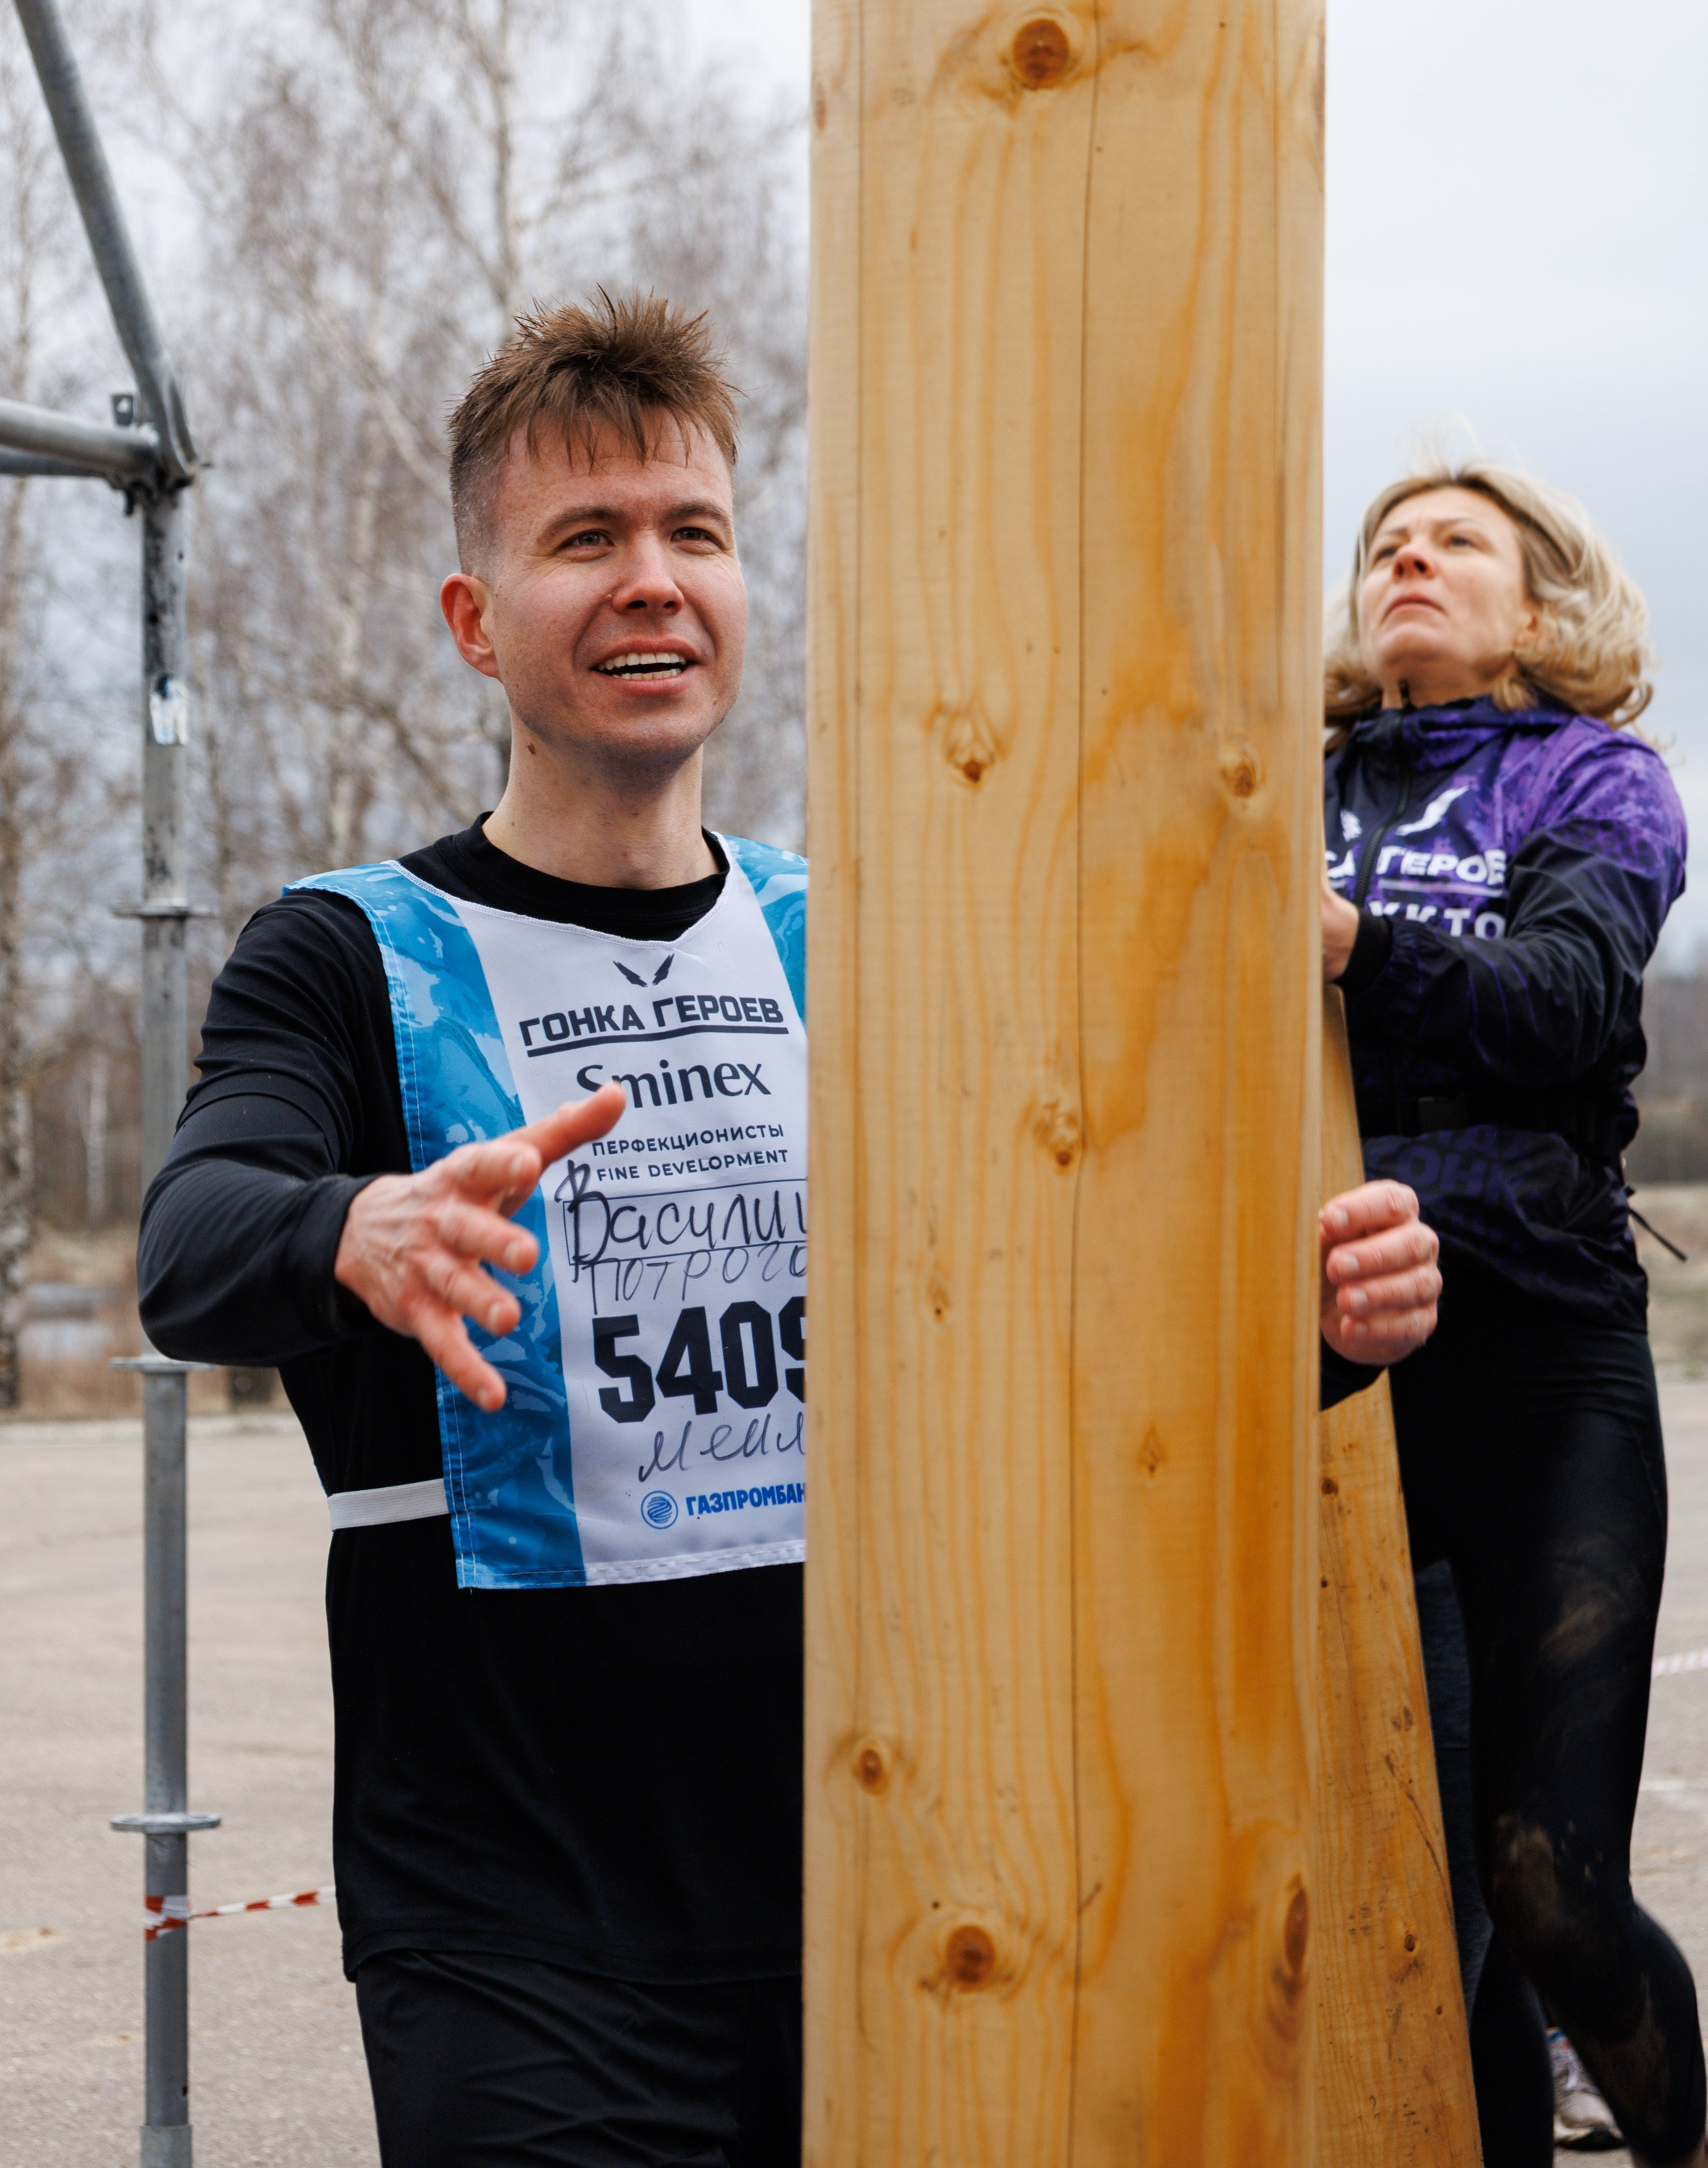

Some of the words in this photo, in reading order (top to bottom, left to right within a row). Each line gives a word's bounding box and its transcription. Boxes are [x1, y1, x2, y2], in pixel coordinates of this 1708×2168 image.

[519, 1004, 646, 1047] ГОНКА
[652, 994, 785, 1028] ГЕРОЕВ
[576, 1058, 772, 1109] Sminex
[591, 1123, 785, 1157] ПЕРФЕКЦИОНИСТЫ
[596, 1165, 641, 1182] FINE
[647, 1148, 788, 1178] DEVELOPMENT
